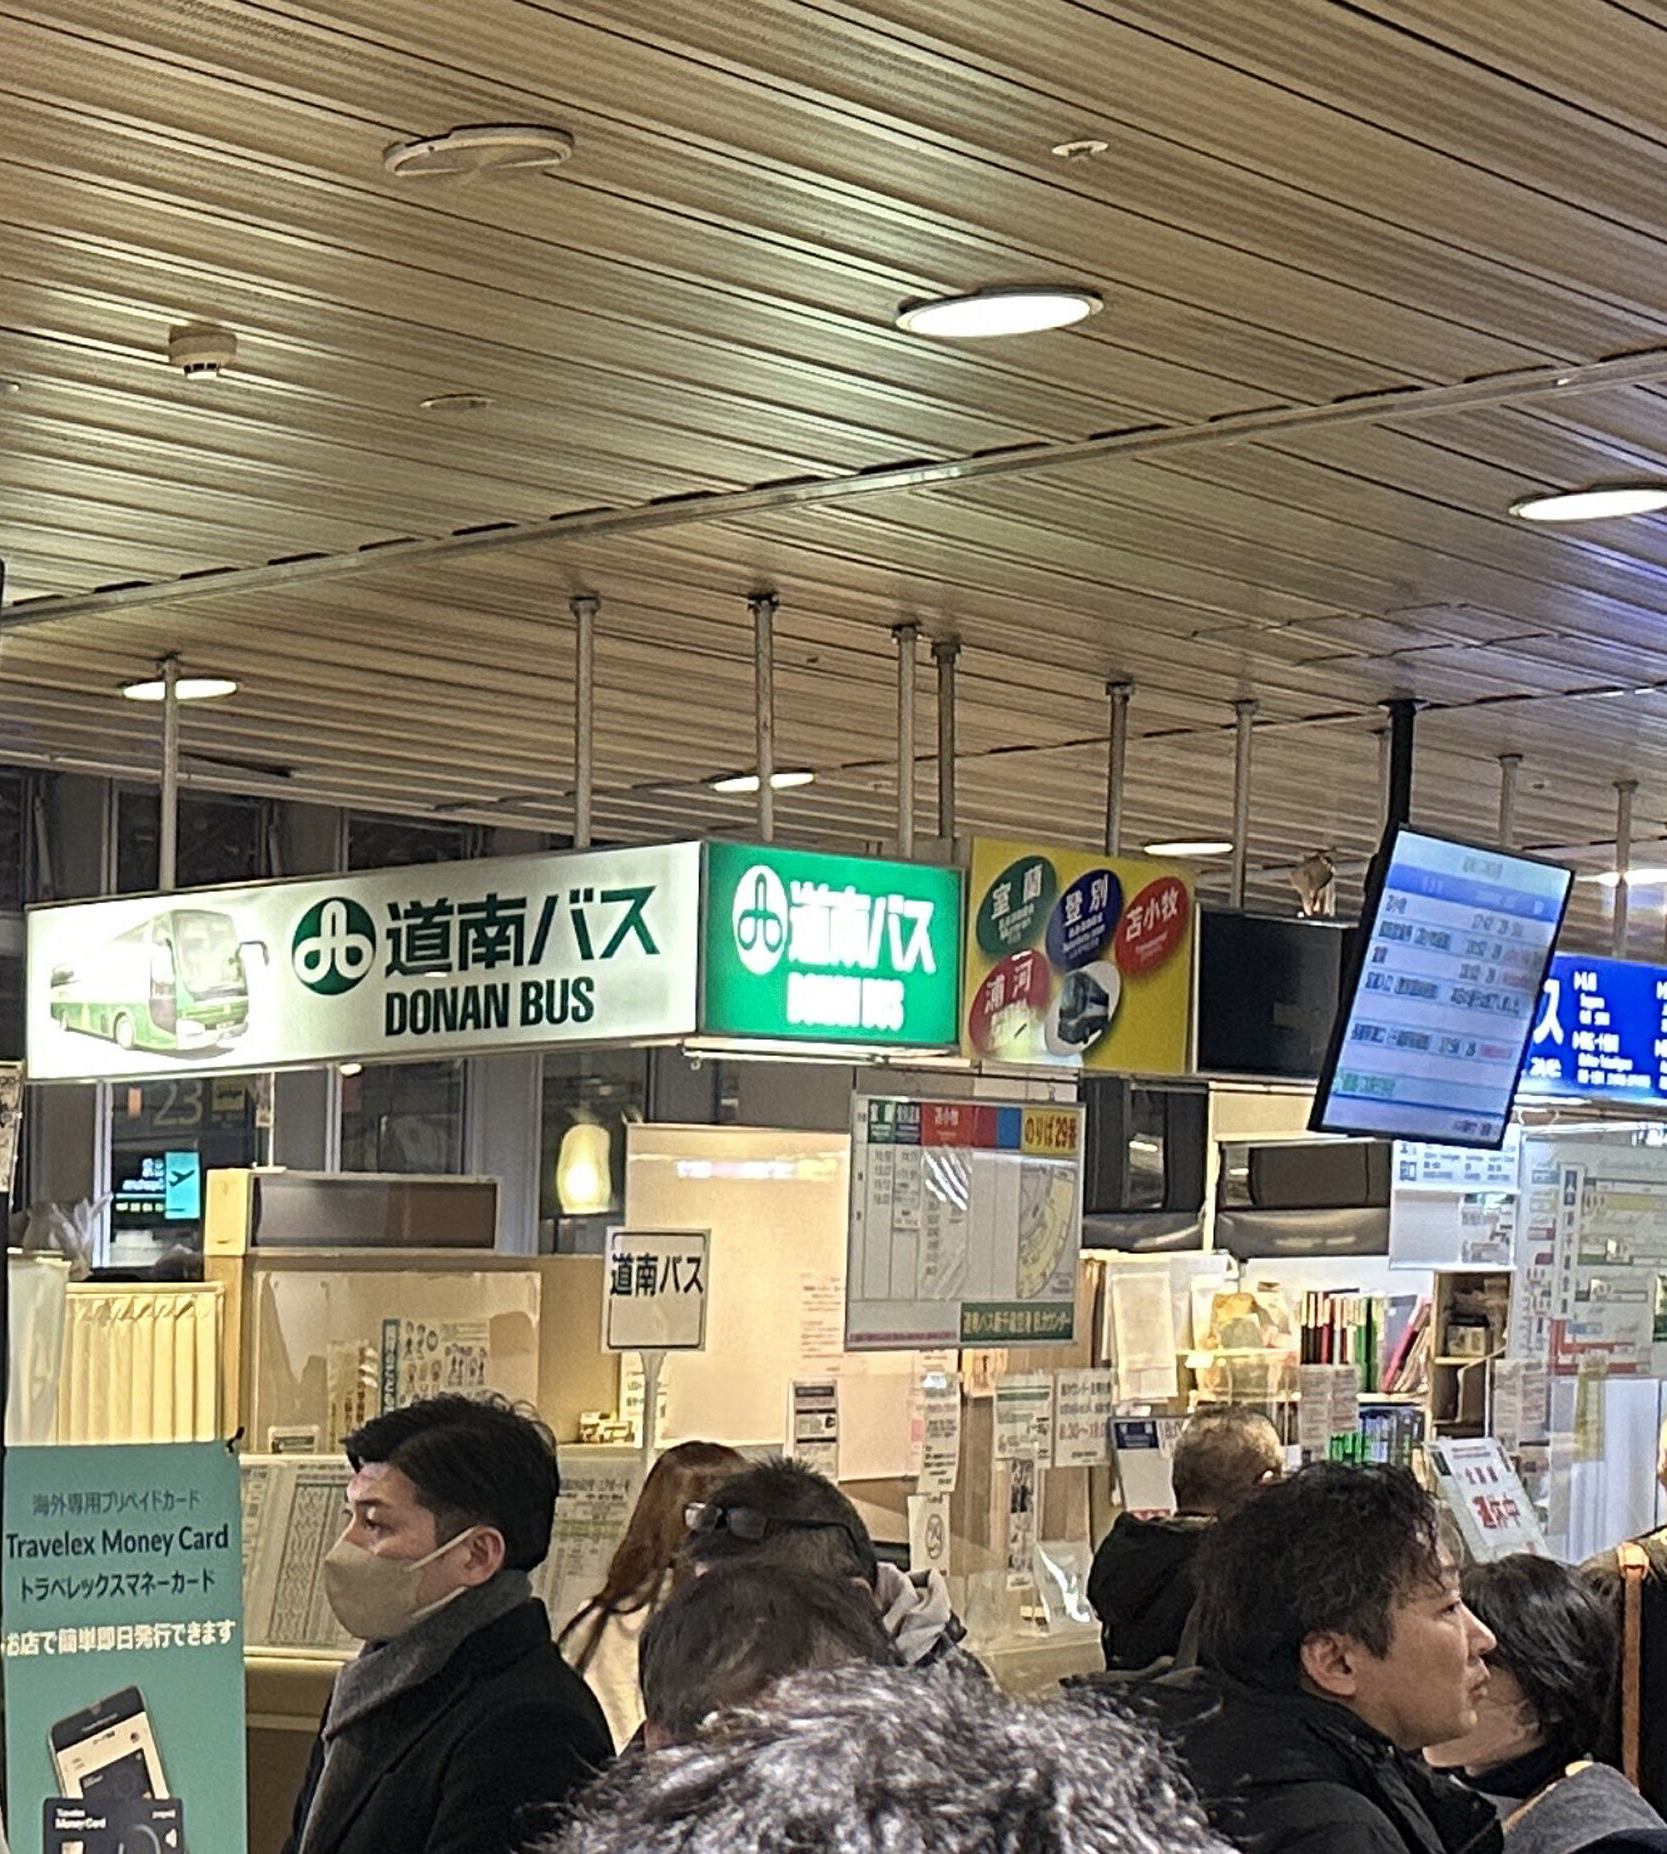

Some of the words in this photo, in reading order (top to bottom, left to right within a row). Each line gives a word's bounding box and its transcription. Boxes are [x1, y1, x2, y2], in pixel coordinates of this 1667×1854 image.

[1063, 873, 1109, 927] 登別
[1125, 886, 1180, 942] 苫小牧
[385, 884, 661, 978] 道南バス
[789, 880, 937, 975] 道南バス
[384, 984, 511, 1038] DONAN
[520, 975, 595, 1027] BUS
[608, 1251, 706, 1300] 道南バス
[32, 1488, 200, 1517] 海外専用プリペイドカード
[6, 1530, 96, 1559] Travelex
[101, 1528, 175, 1558] Money
[178, 1523, 230, 1551] Card
[20, 1567, 216, 1603] トラベレックスマネーカード
